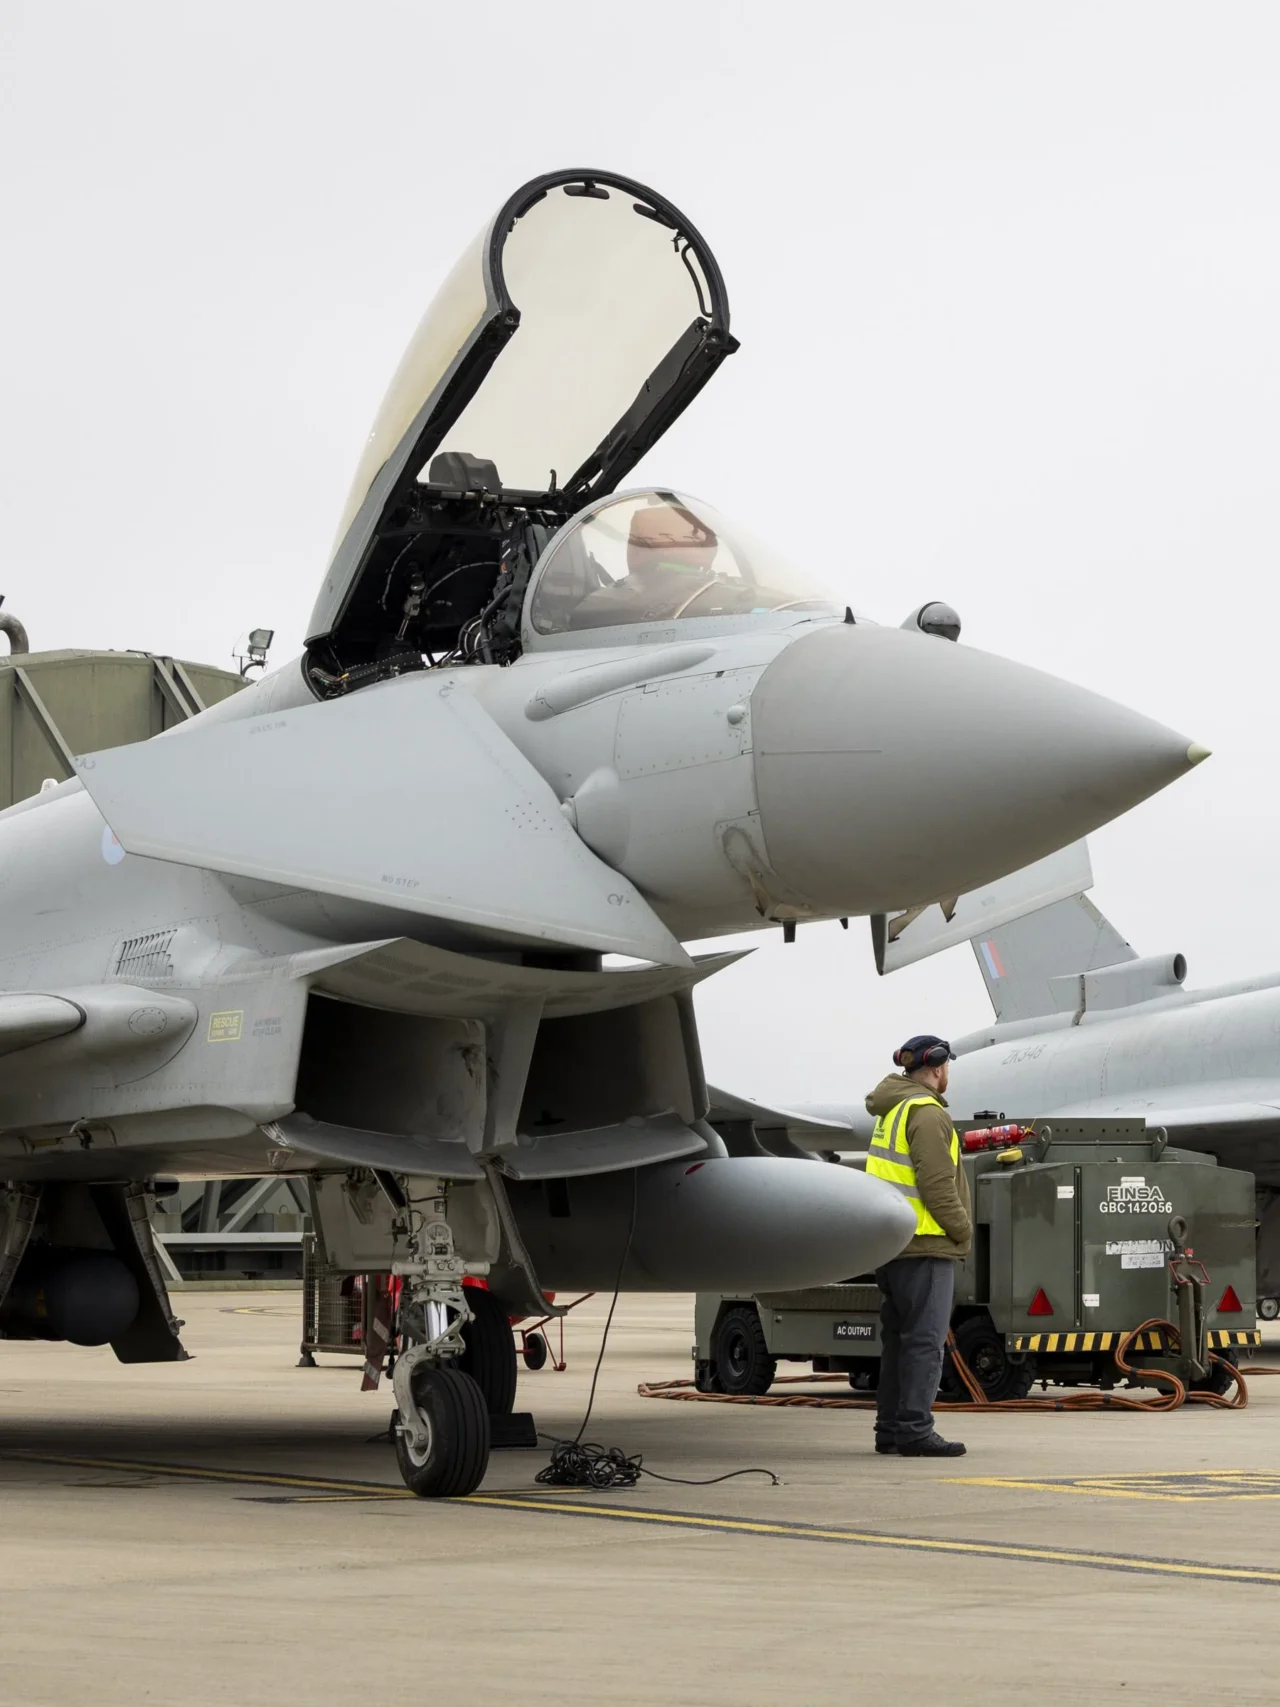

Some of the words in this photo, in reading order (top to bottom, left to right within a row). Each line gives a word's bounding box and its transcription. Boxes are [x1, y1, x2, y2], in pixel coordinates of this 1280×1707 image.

[380, 874, 394, 884] NO
[395, 877, 420, 888] STEP
[212, 1016, 240, 1029] RESCUE
[1107, 1186, 1165, 1201] EINSA
[1099, 1201, 1173, 1214] GBC142056
[837, 1326, 846, 1335] AC
[848, 1326, 872, 1336] OUTPUT
